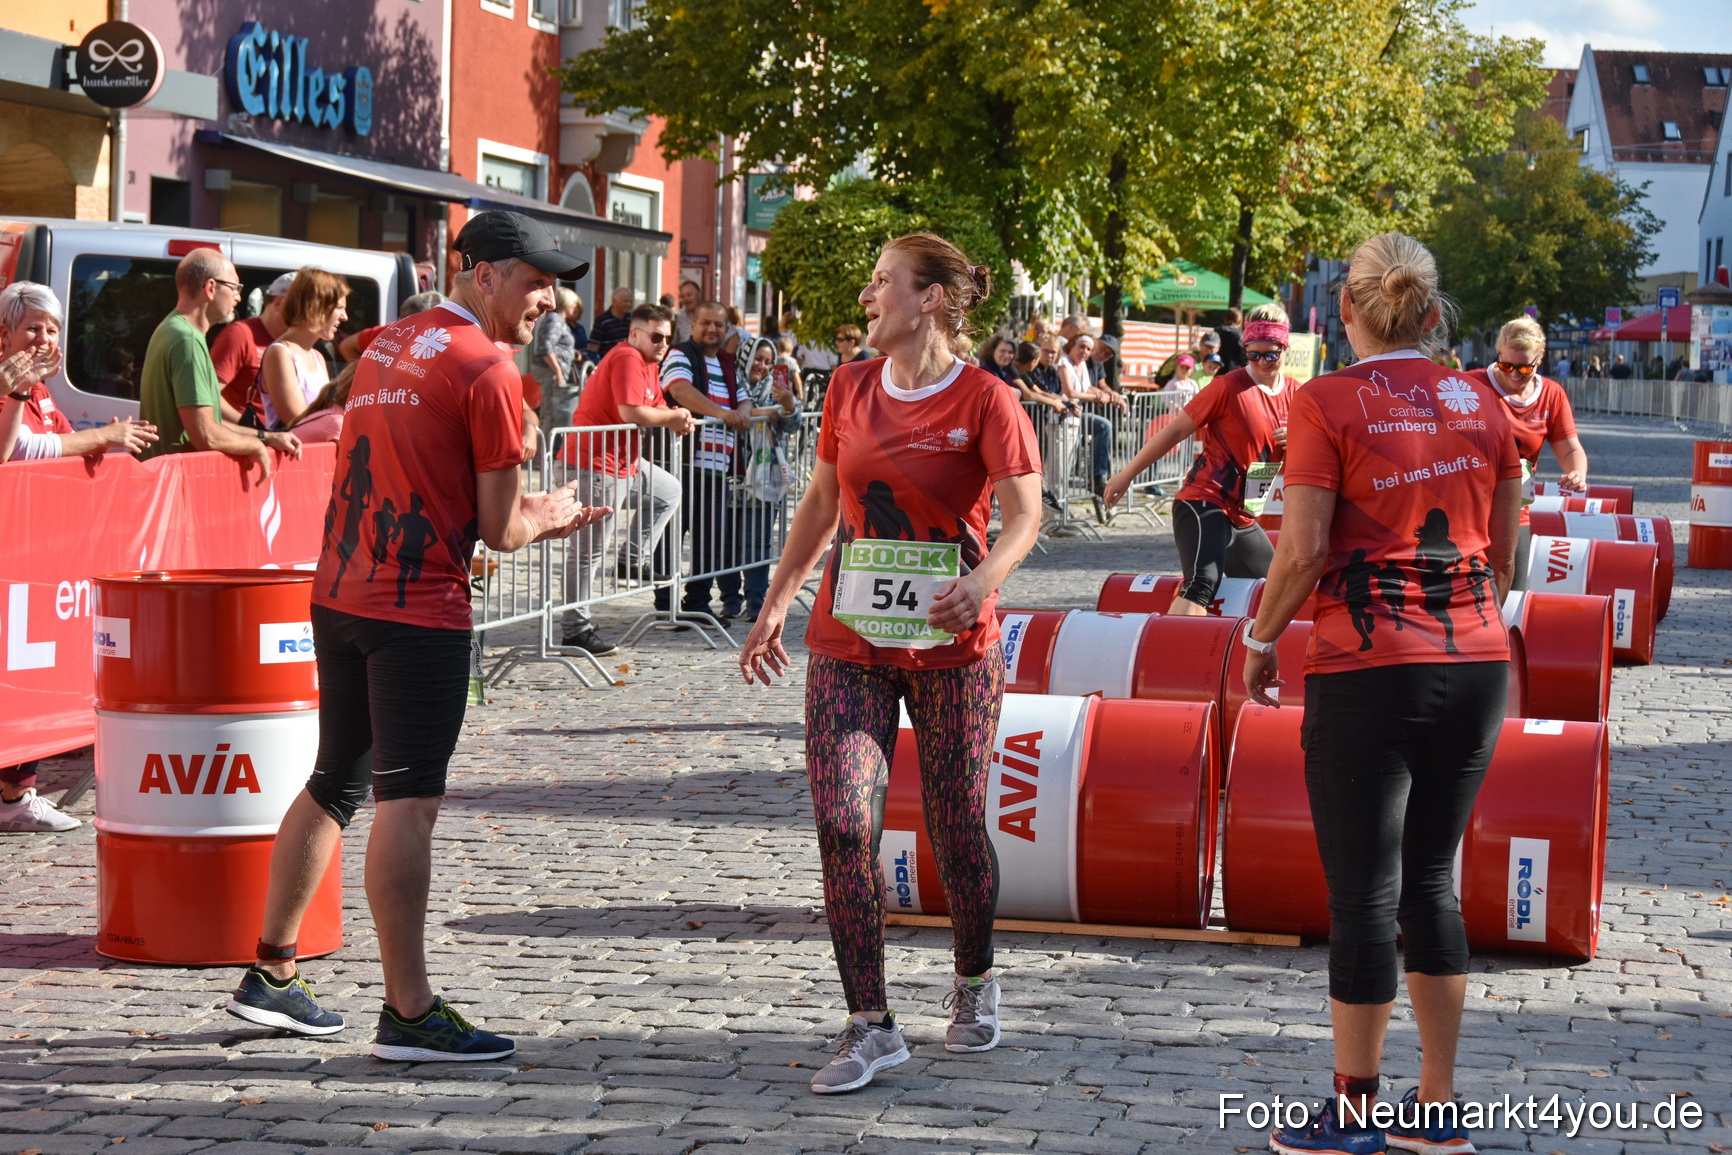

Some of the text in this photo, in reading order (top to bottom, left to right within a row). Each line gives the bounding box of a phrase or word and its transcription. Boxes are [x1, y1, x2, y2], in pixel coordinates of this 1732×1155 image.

[237, 20, 347, 130] Eilles
[374, 337, 402, 353] caritas
[396, 359, 426, 378] caritas
[354, 393, 375, 408] uns
[1389, 406, 1434, 417] caritas
[1367, 419, 1437, 435] nürnberg
[1446, 417, 1487, 431] caritas
[1372, 471, 1400, 491] bei
[1403, 467, 1431, 483] uns
[849, 544, 949, 572] BOCK
[871, 578, 918, 611] 54
[854, 619, 933, 636] KORONA
